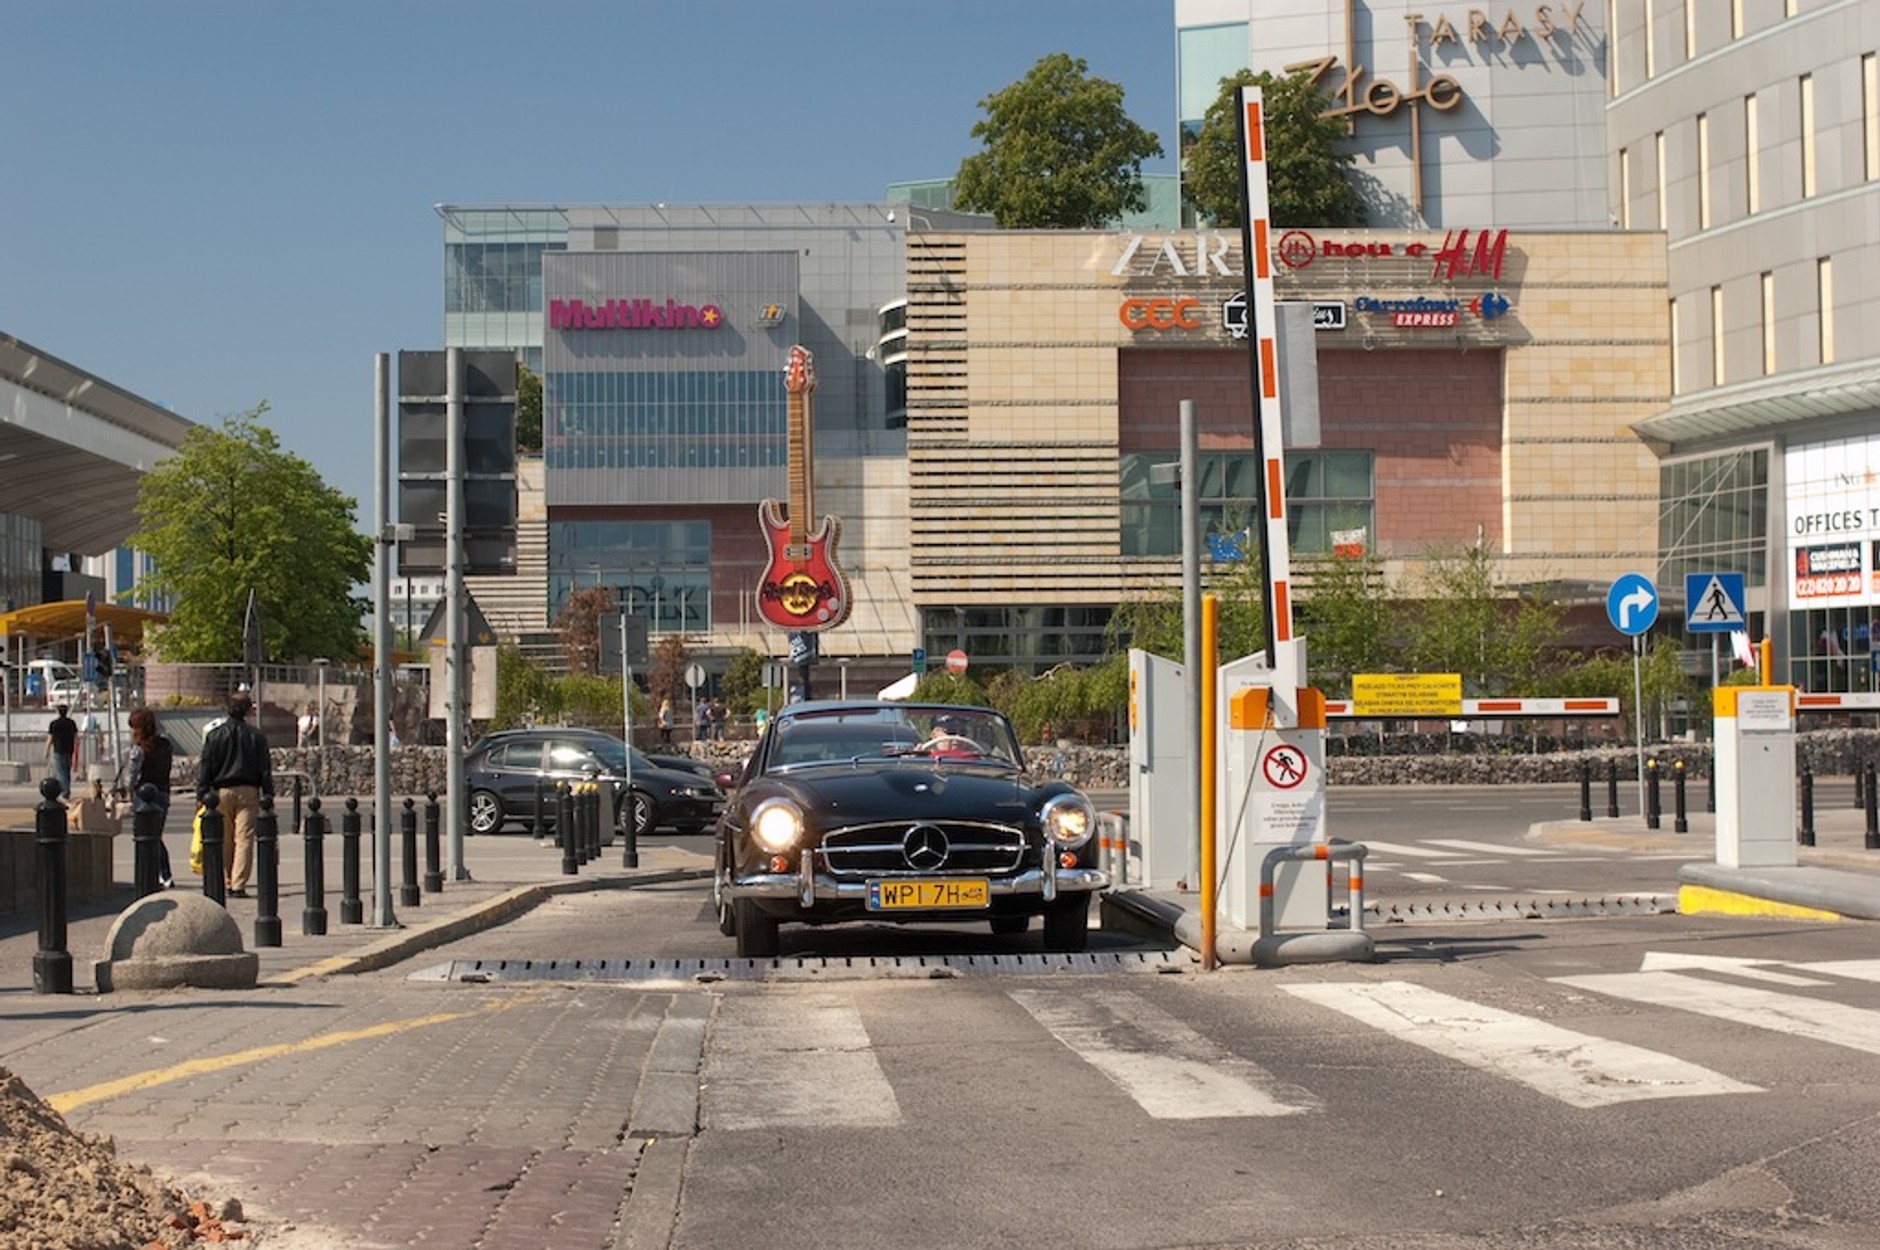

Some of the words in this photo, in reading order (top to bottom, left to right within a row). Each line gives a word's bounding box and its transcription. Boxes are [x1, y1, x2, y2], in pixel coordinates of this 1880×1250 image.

[1404, 1, 1585, 47] TARASY
[1109, 234, 1282, 277] ZAR
[550, 298, 722, 330] Multikino
[1120, 298, 1200, 330] CCC
[1395, 313, 1455, 326] EXPRESS
[1794, 510, 1863, 535] OFFICES
[933, 885, 960, 904] 7H
